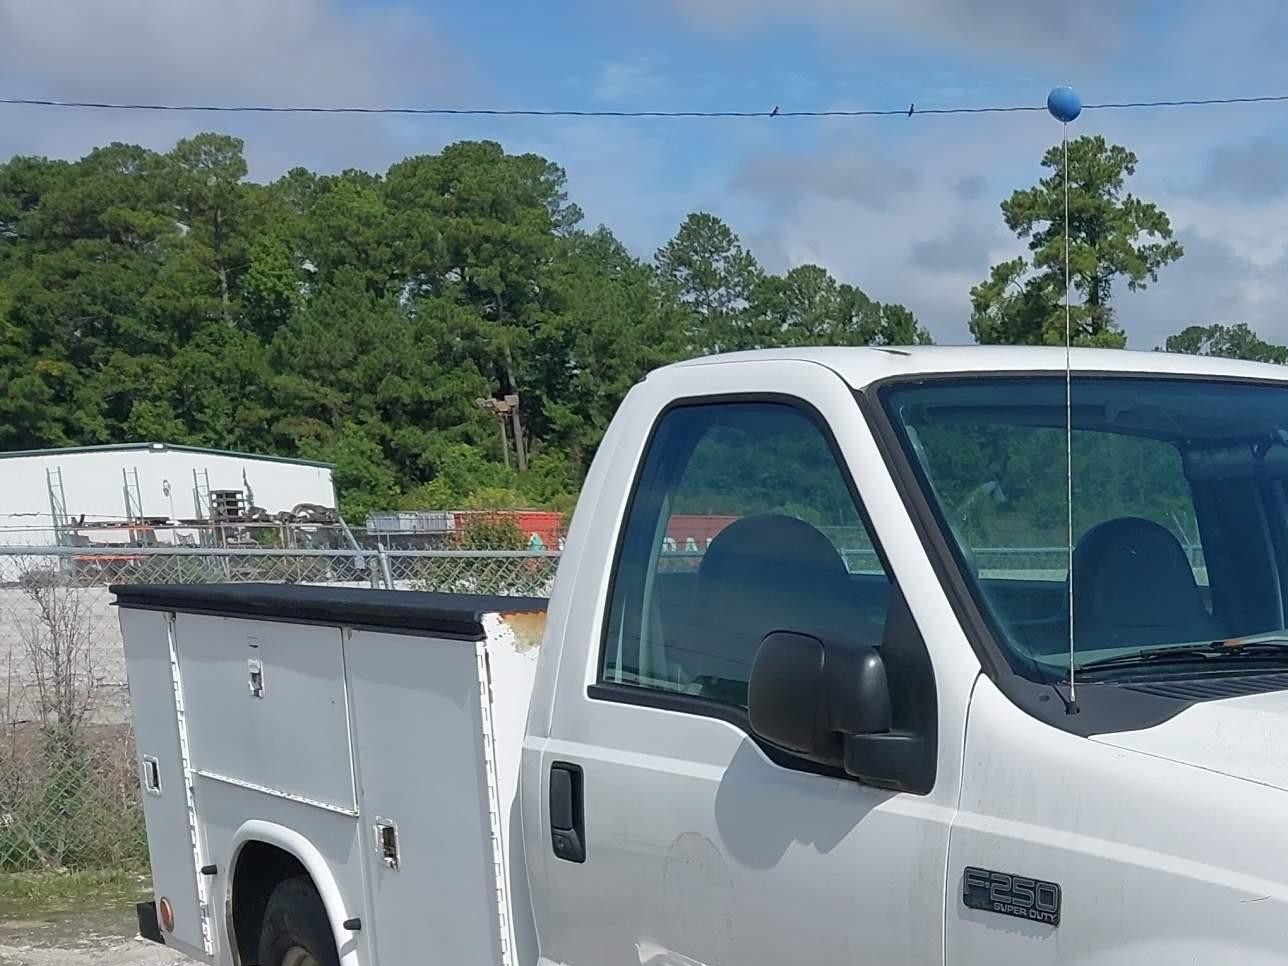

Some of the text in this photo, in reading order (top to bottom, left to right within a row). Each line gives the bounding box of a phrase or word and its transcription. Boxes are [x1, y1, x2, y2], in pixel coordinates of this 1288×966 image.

[964, 868, 1059, 913] F-250
[993, 902, 1058, 922] SUPER DUTY
